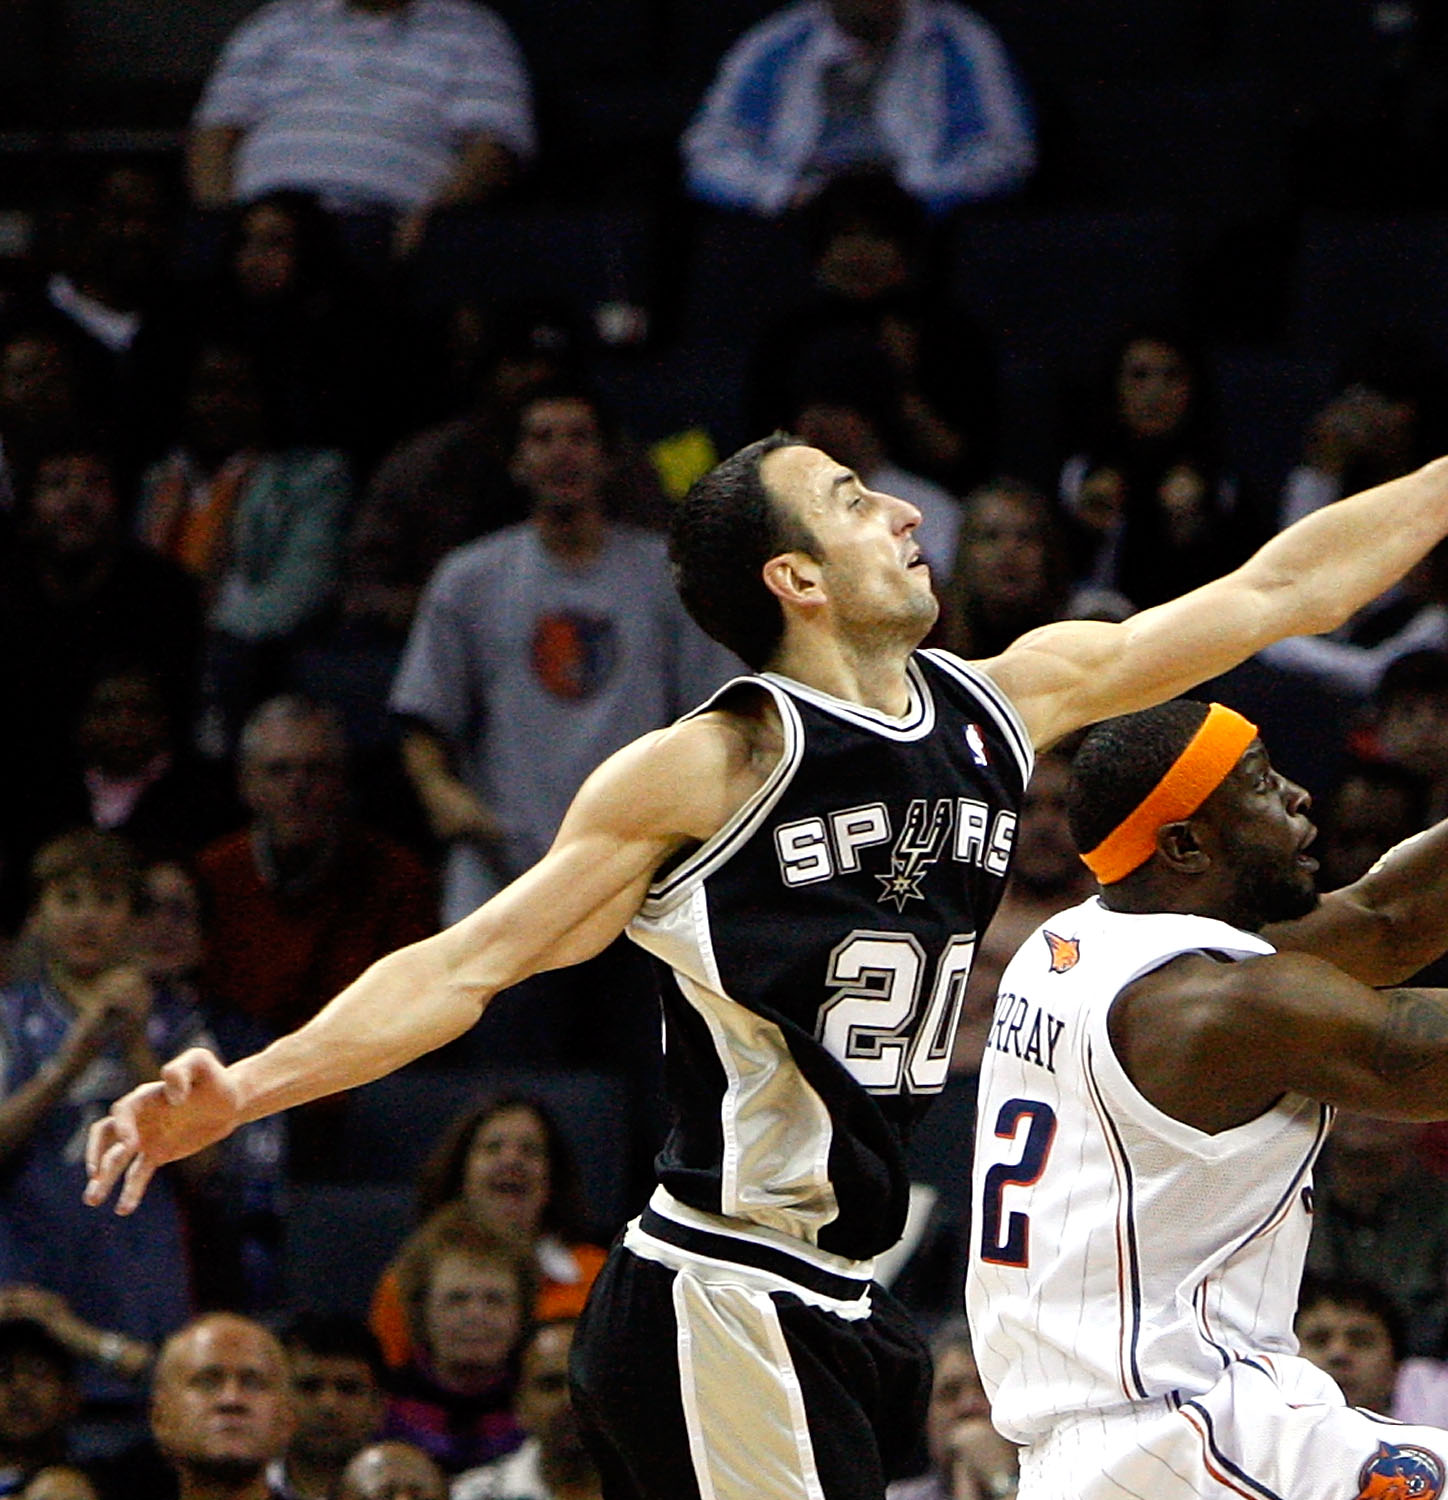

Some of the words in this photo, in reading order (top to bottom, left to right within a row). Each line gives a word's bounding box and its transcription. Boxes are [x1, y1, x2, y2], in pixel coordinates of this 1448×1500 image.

[773, 797, 1018, 912] SPURS
[814, 929, 977, 1095] 20
[986, 992, 1065, 1074] RRAY
[981, 1098, 1057, 1268] 2
